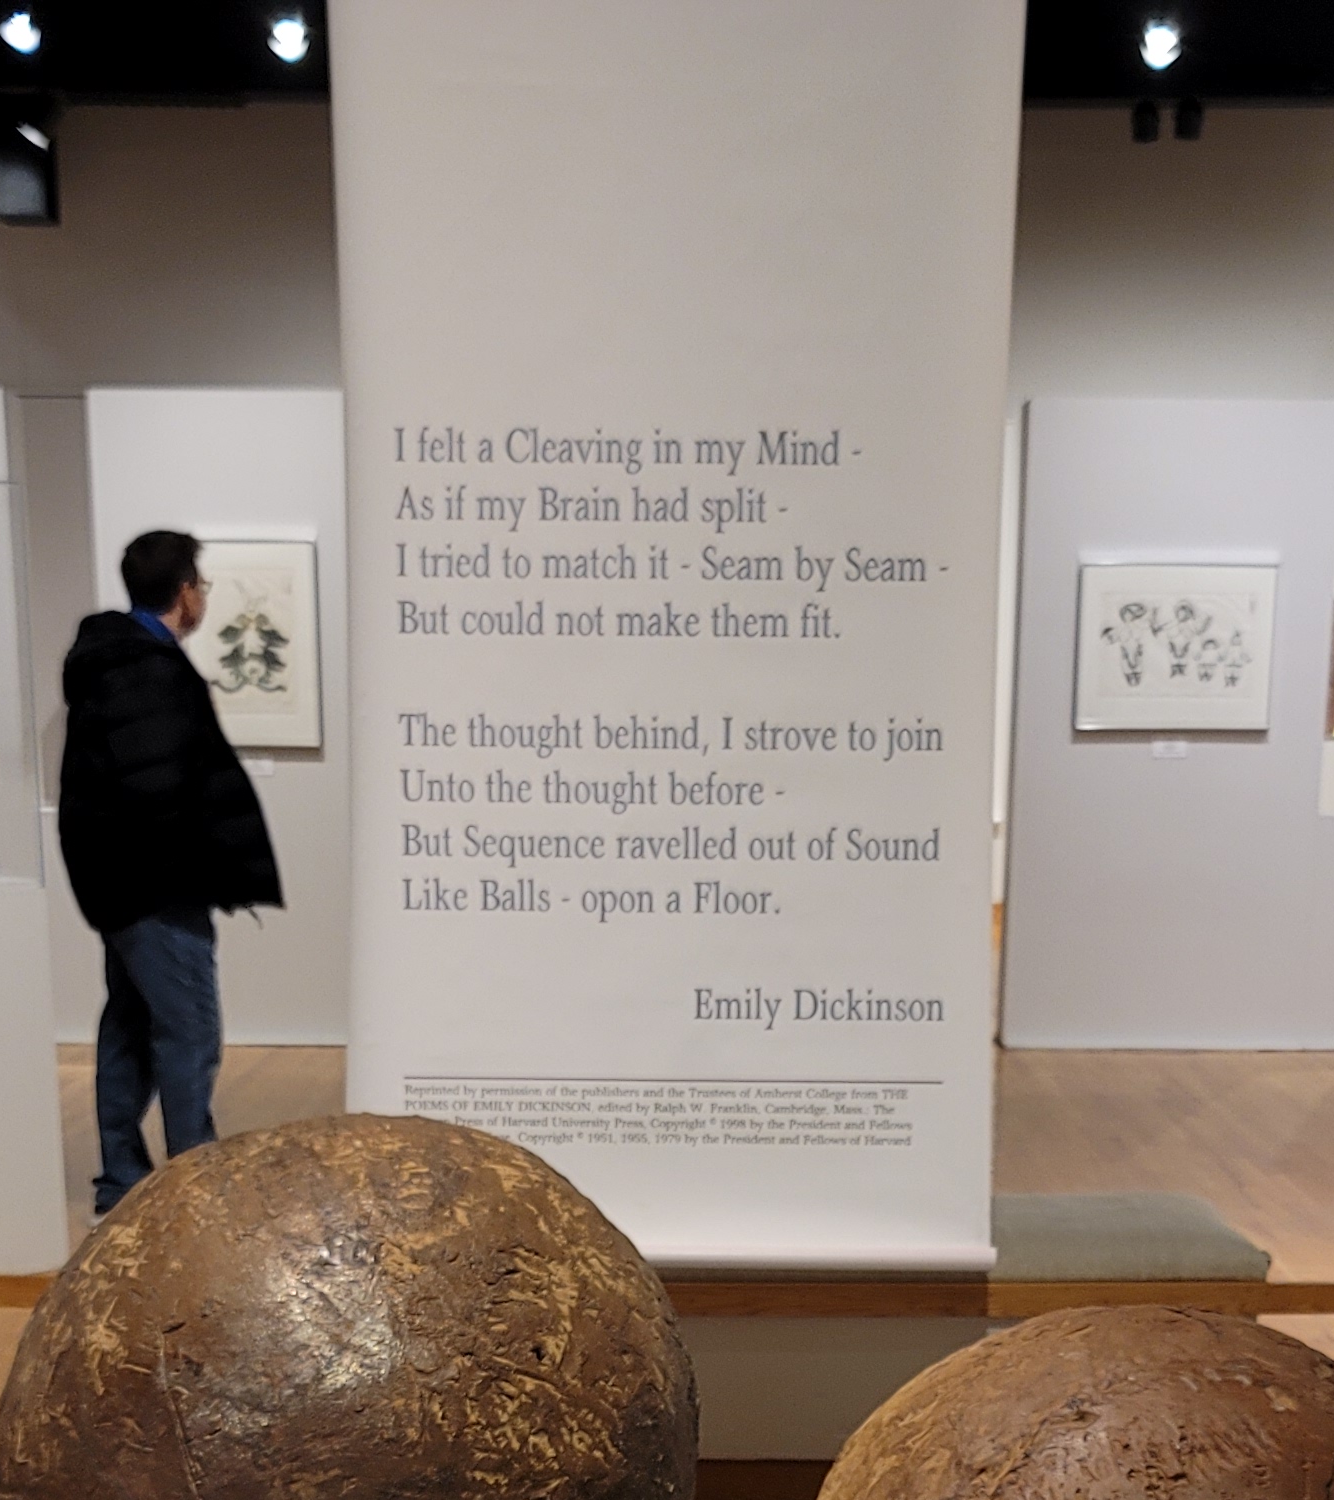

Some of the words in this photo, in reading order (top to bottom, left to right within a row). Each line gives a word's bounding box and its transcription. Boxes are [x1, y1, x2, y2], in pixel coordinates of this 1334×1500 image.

[394, 427, 405, 462] I
[417, 426, 466, 463] felt
[478, 438, 493, 463] a
[505, 427, 643, 475] Cleaving
[653, 428, 682, 464] in
[694, 439, 746, 476] my
[756, 429, 840, 466] Mind
[395, 485, 434, 520] As
[445, 484, 467, 520] if
[476, 496, 526, 532] my
[538, 486, 620, 521] Brain
[632, 486, 689, 522] had
[701, 487, 766, 534] split
[396, 542, 407, 577] I
[419, 542, 490, 578] tried
[502, 547, 531, 579] to
[542, 544, 636, 579] match
[648, 545, 669, 580] it
[701, 545, 783, 581] Seam
[794, 545, 835, 593] by
[844, 546, 927, 582] Seam
[397, 600, 449, 635] But
[461, 600, 544, 636] could
[555, 606, 604, 636] not
[616, 601, 701, 637] make
[711, 602, 789, 638] them
[801, 602, 840, 639] fit.
[398, 712, 456, 747] The
[467, 713, 583, 759] thought
[593, 714, 709, 756] behind,
[722, 716, 733, 750] I
[745, 720, 837, 751] strove
[848, 721, 877, 751] to
[883, 717, 943, 762] join
[400, 768, 475, 803] Unto
[485, 769, 532, 803] the
[543, 769, 658, 815] thought
[668, 770, 764, 806] before
[401, 824, 453, 857] But
[464, 824, 605, 868] Sequence
[616, 825, 737, 860] ravelled
[748, 831, 796, 861] out
[807, 826, 838, 861] of
[846, 827, 940, 861] Sound
[402, 877, 468, 911] Like
[479, 878, 551, 912] Balls
[581, 890, 655, 923] opon
[666, 890, 681, 913] a
[694, 880, 780, 915] Floor.
[694, 987, 782, 1030] Emily
[793, 988, 944, 1022] Dickinson
[405, 1100, 449, 1110] POEMS
[451, 1100, 469, 1111] OF
[473, 1101, 514, 1112] EMILY
[598, 1102, 632, 1113] edited
[635, 1102, 650, 1116] by
[654, 1102, 686, 1116] Ralph
[873, 1104, 895, 1115] The
[463, 1085, 477, 1099] by
[546, 1086, 557, 1096] of
[560, 1087, 578, 1096] the
[581, 1087, 639, 1100] publishers
[643, 1087, 664, 1097] and
[667, 1087, 685, 1097] the
[739, 1088, 751, 1098] of
[755, 1088, 802, 1098] Amherst
[805, 1088, 847, 1102] College
[851, 1089, 878, 1099] from
[487, 1116, 498, 1126] of
[502, 1116, 548, 1127] Harvard
[552, 1117, 610, 1131] University
[650, 1118, 706, 1132] Copyright
[749, 1119, 764, 1133] by
[767, 1119, 785, 1129] the
[789, 1119, 841, 1130] President
[844, 1120, 865, 1130] and
[517, 1132, 574, 1146] Copyright
[683, 1133, 699, 1147] by
[702, 1133, 719, 1144] the
[723, 1134, 775, 1144] President
[779, 1135, 800, 1145] and
[849, 1135, 861, 1145] of
